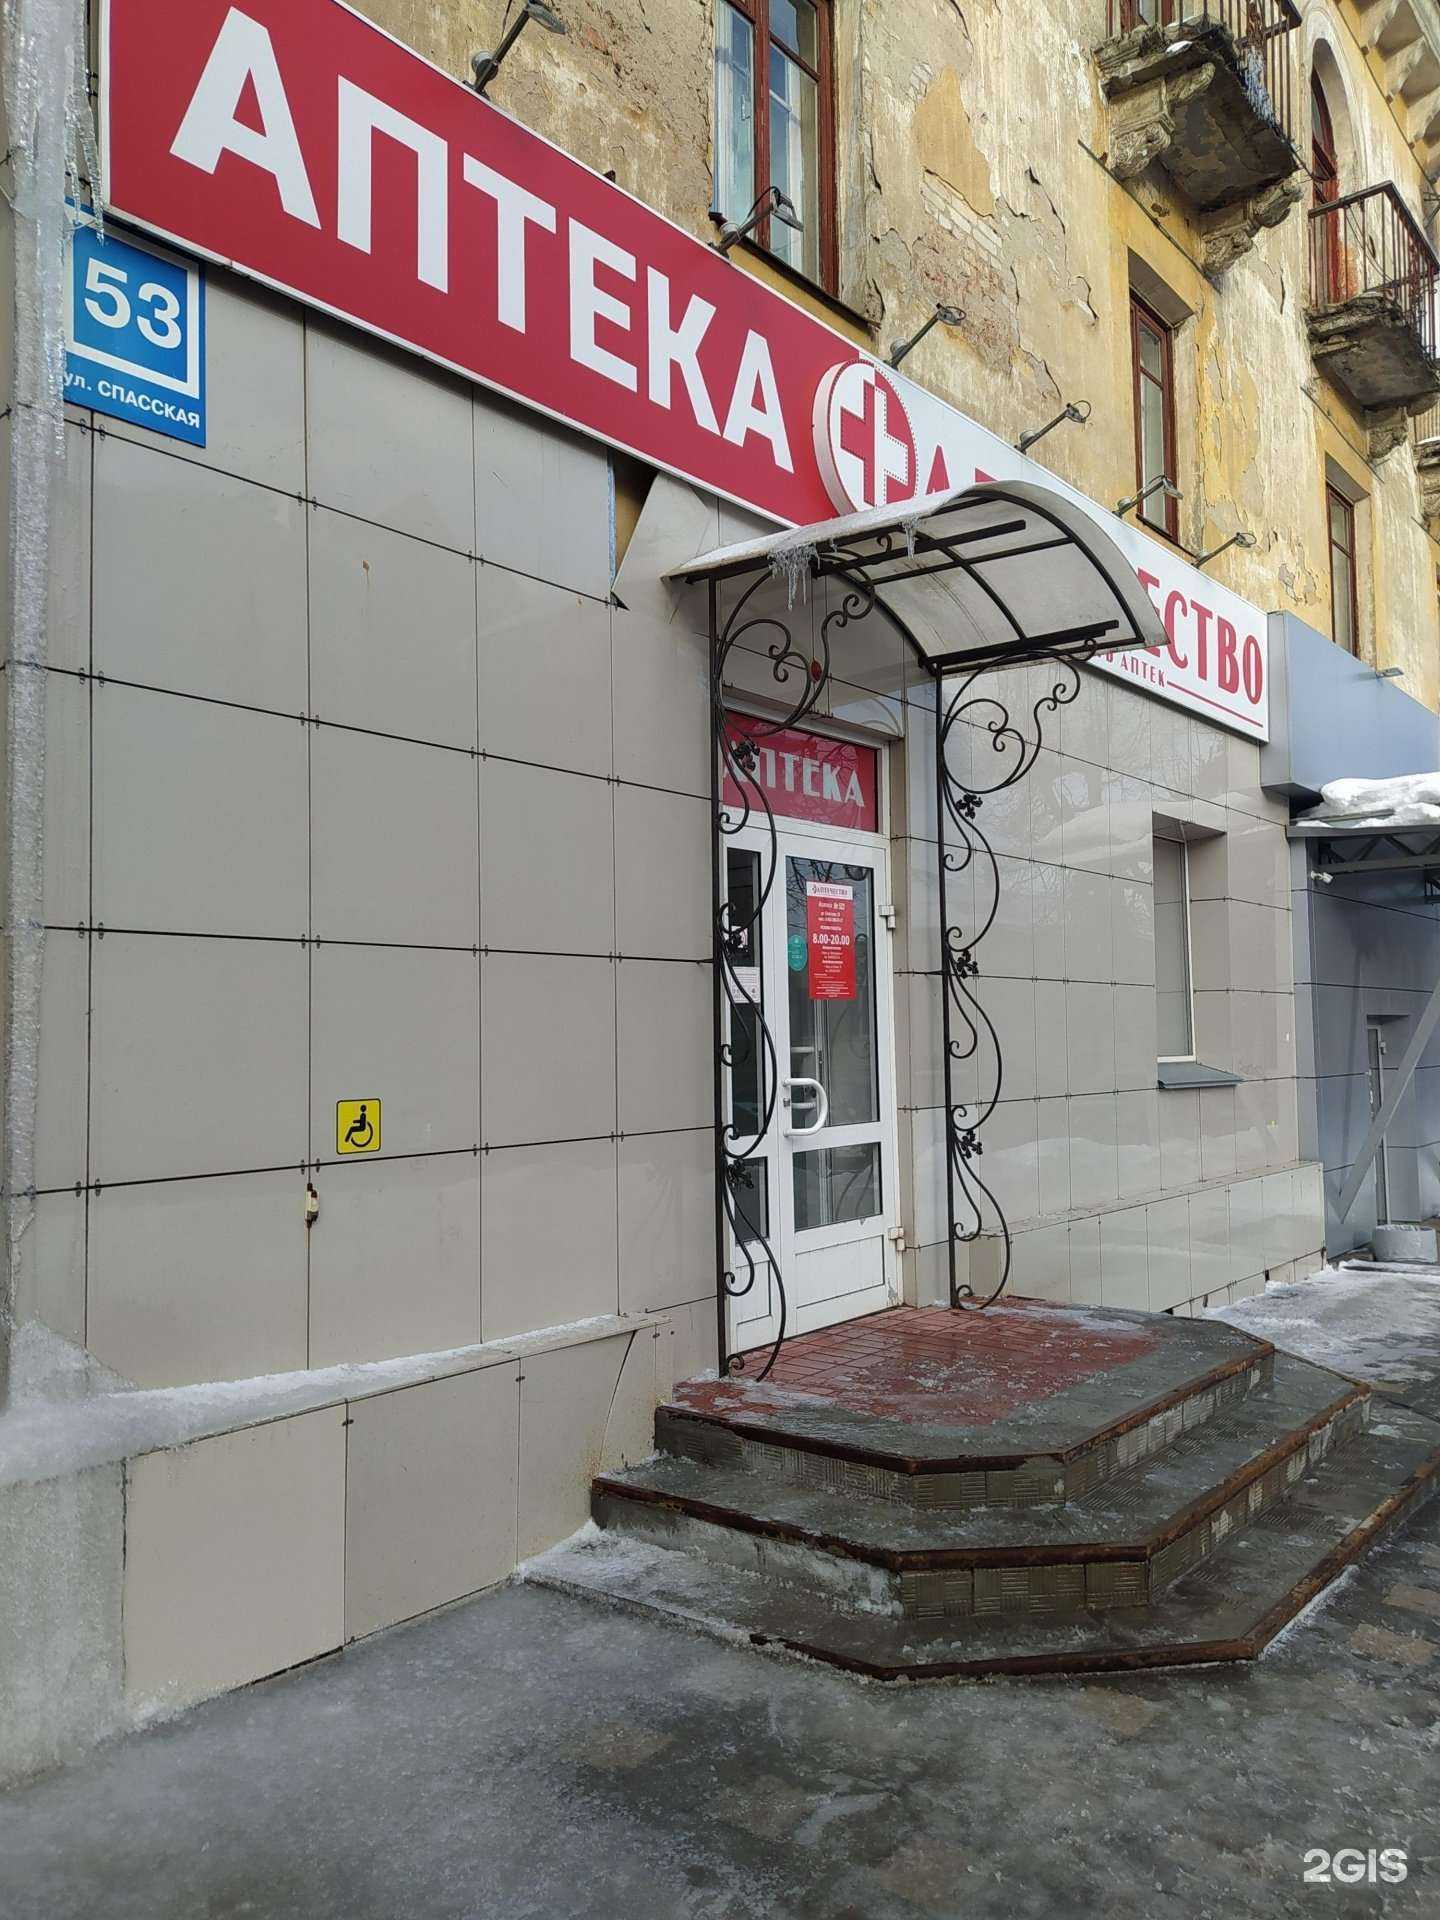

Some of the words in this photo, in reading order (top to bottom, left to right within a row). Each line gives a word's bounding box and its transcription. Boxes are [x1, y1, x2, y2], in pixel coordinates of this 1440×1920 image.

[169, 5, 795, 474] АПТЕКА
[84, 256, 182, 349] 53
[63, 369, 92, 391] ул.
[97, 379, 200, 429] СПАССКАЯ
[1120, 653, 1165, 688] АПТЕК
[812, 932, 850, 946] 8.00-20.00
